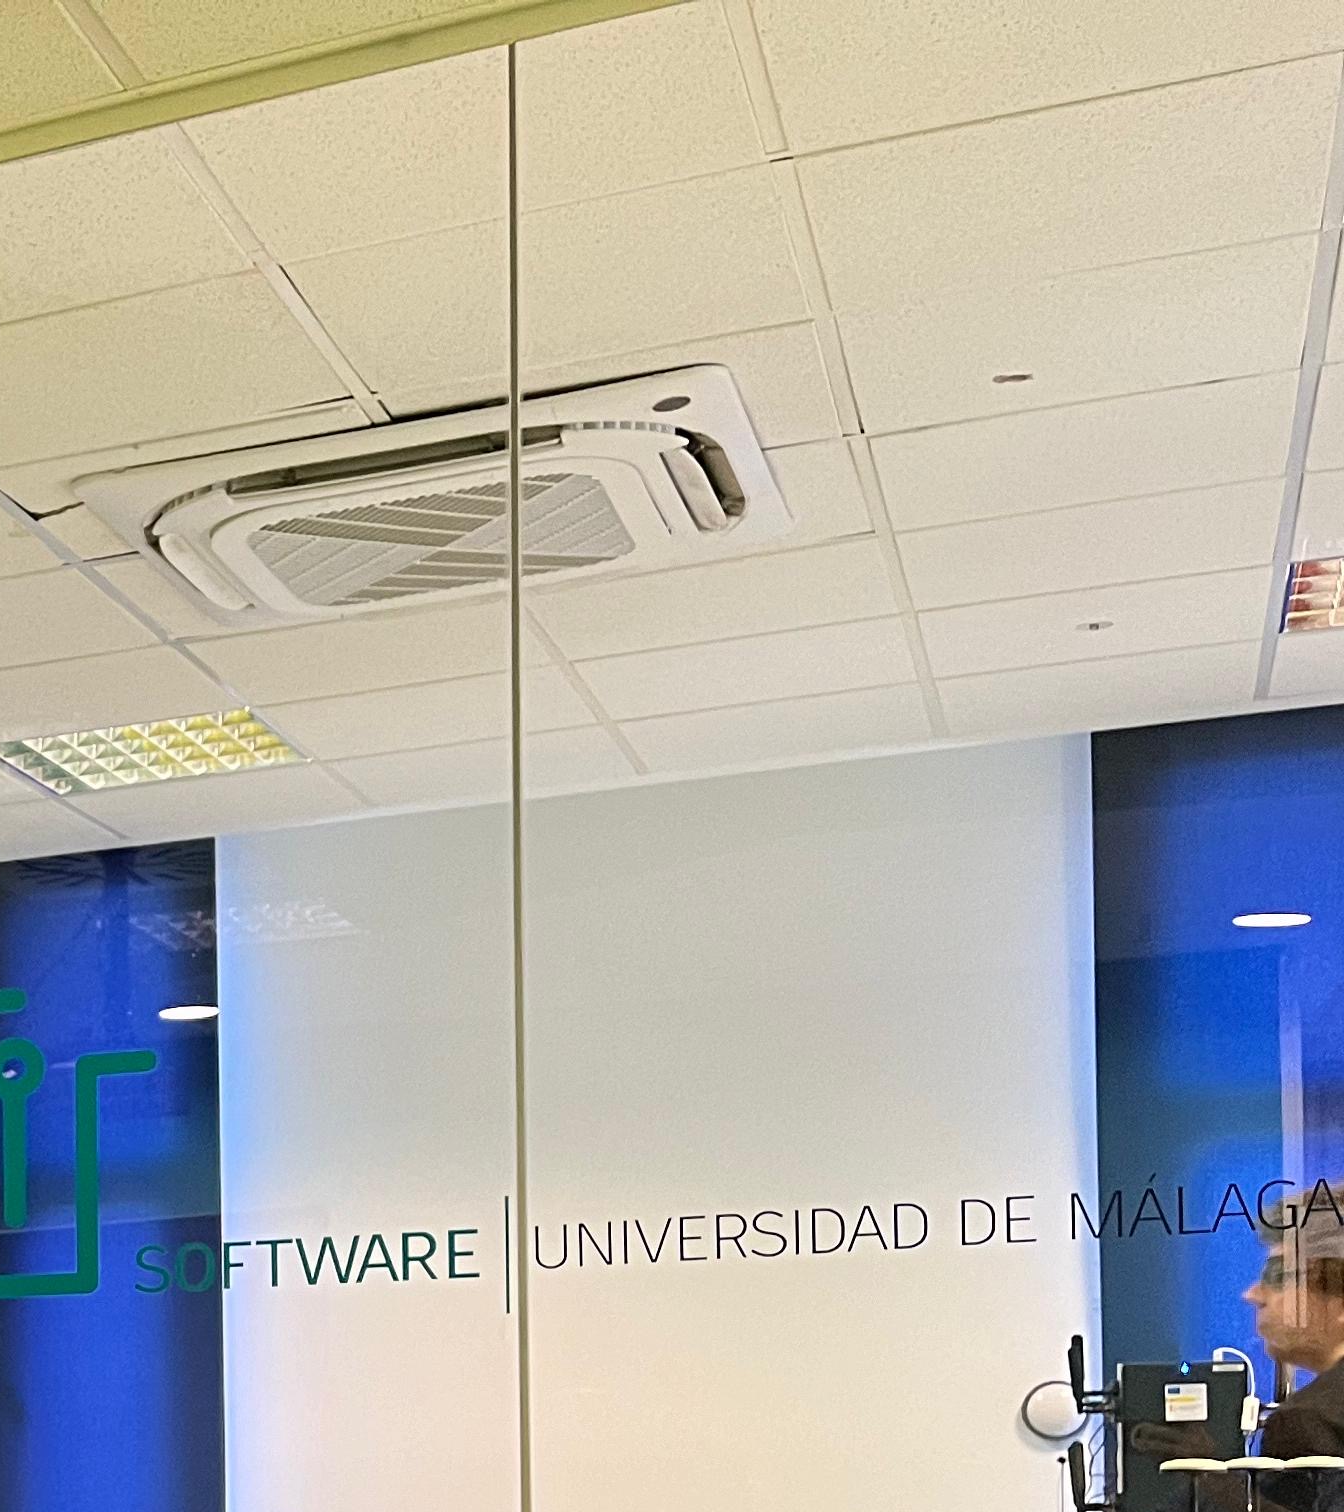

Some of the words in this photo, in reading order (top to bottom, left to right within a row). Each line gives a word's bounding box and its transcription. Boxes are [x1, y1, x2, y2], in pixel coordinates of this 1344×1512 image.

[134, 1228, 481, 1295] SOFTWARE
[533, 1202, 929, 1270] UNIVERSIDAD
[960, 1195, 1037, 1246] DE
[1070, 1173, 1344, 1241] MÁLAGA
